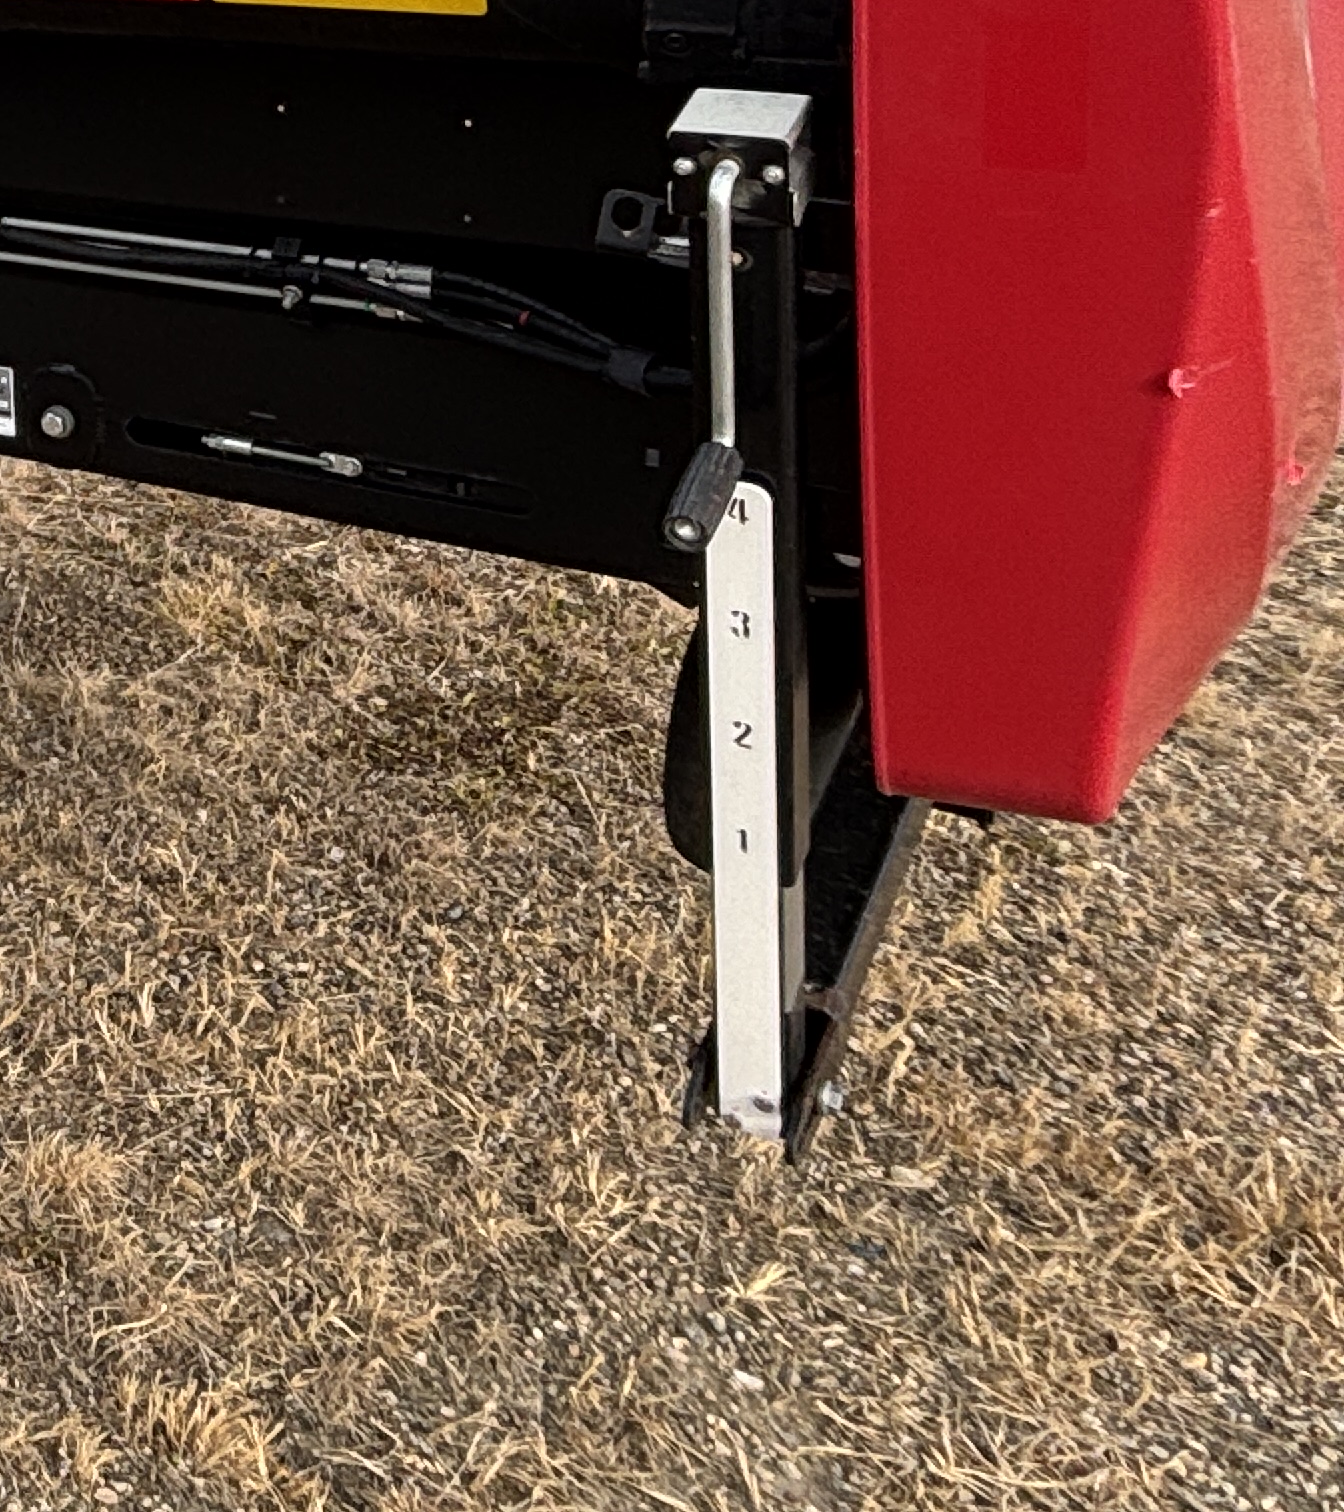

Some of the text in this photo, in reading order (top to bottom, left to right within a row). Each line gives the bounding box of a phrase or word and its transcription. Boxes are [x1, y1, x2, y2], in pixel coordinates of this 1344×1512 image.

[727, 496, 750, 526] 4
[730, 609, 750, 640] 3
[732, 720, 753, 751] 2
[736, 828, 749, 854] 1
